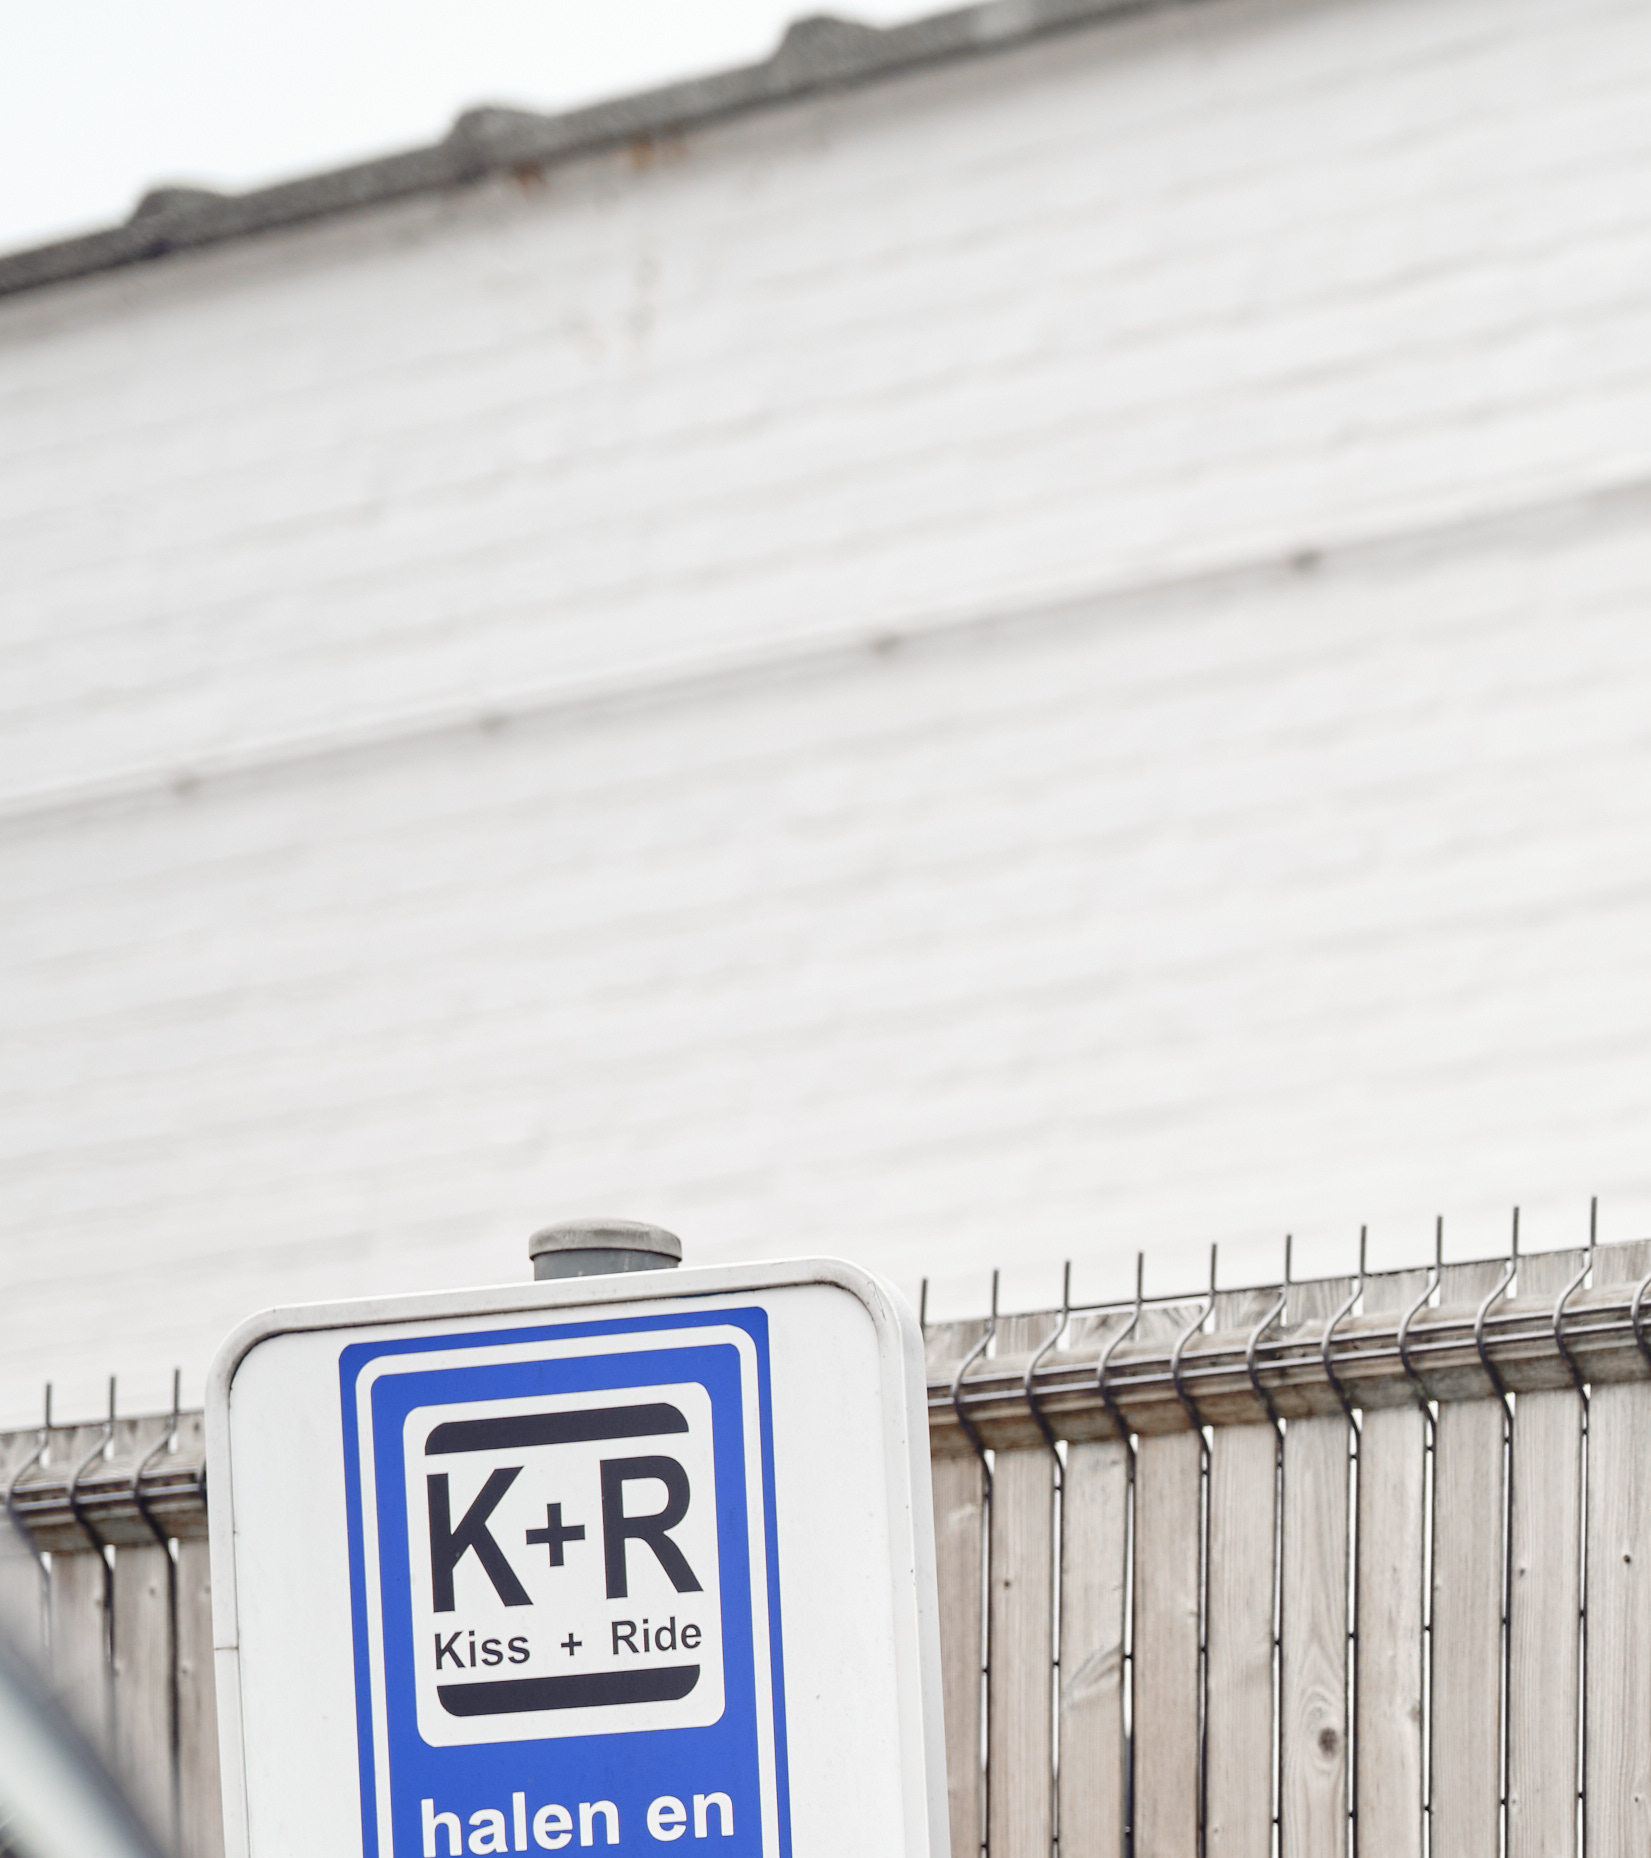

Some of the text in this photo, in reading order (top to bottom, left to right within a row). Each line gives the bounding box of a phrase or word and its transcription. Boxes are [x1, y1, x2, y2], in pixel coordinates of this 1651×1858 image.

[427, 1455, 704, 1613] K+R
[434, 1630, 531, 1670] Kiss
[611, 1616, 702, 1655] Ride
[421, 1791, 734, 1858] halen en
